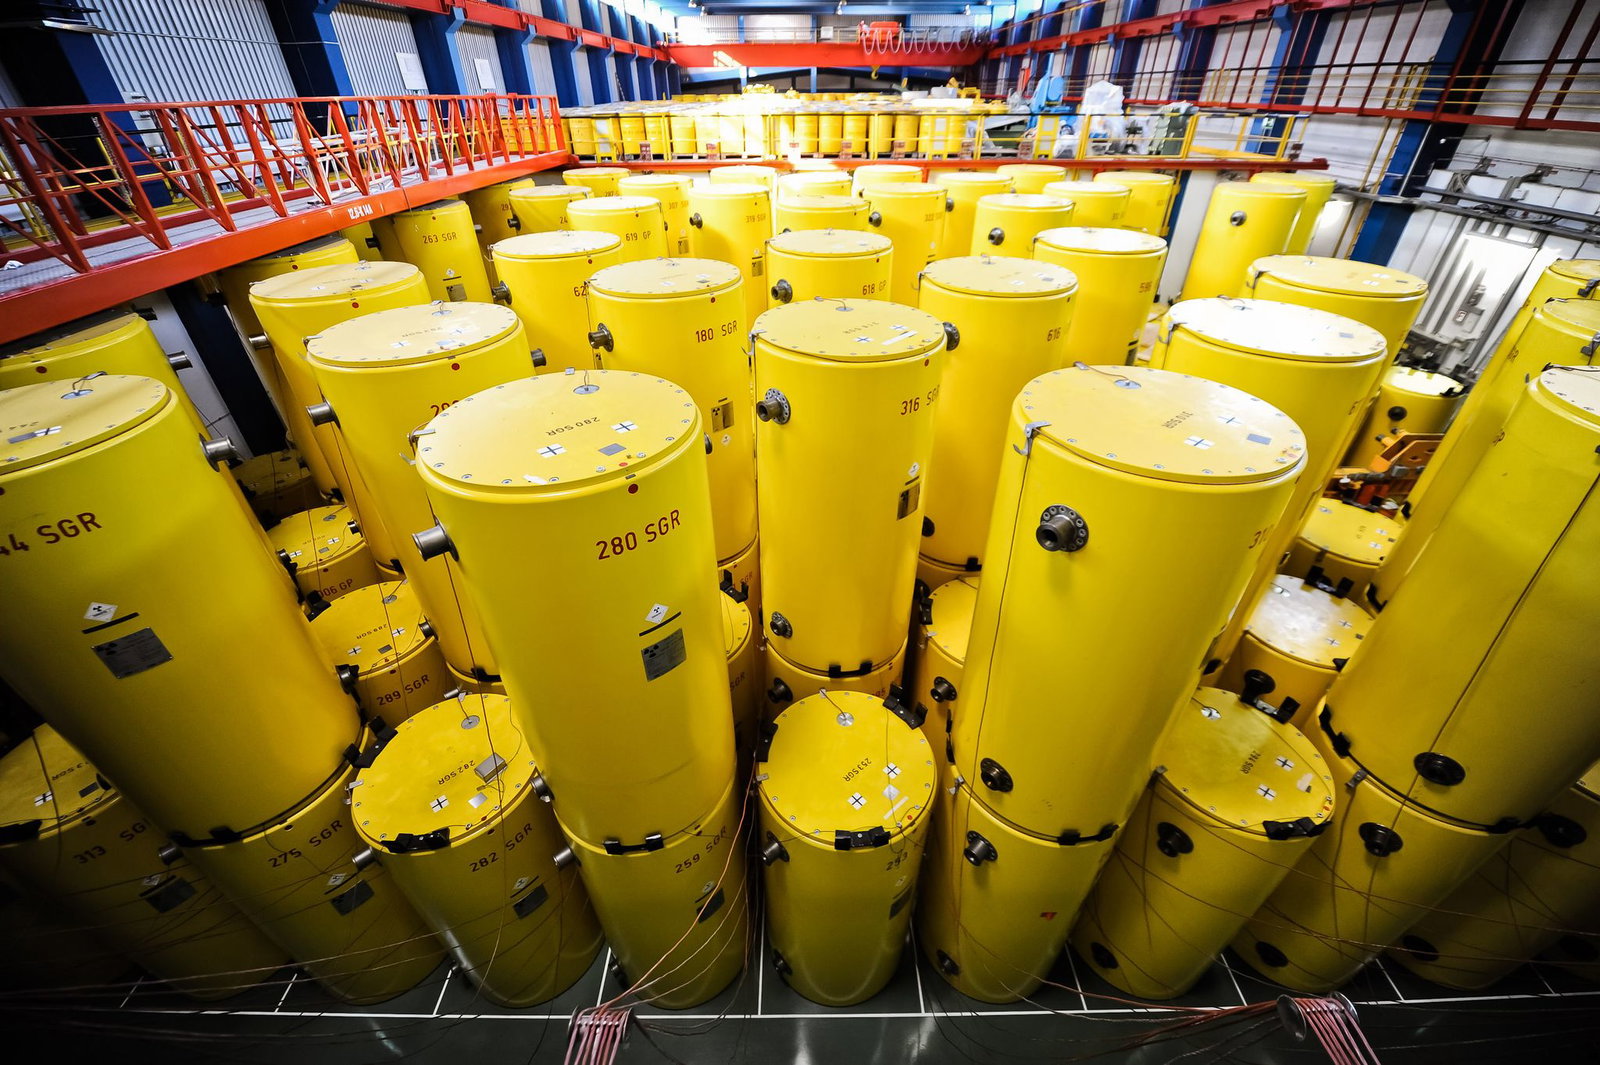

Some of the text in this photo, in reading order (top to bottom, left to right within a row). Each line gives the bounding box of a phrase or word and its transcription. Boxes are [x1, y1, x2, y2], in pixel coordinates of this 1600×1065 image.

[422, 231, 458, 245] 263 SGR
[625, 230, 652, 241] 619 GP
[573, 285, 588, 297] 62
[862, 284, 875, 296] 618
[696, 320, 738, 343] 180 SGR
[900, 397, 920, 416] 316
[546, 417, 600, 437] 280 SGR
[37, 512, 102, 544] SGR
[596, 509, 681, 560] 280 SGR
[339, 578, 354, 590] GP
[376, 674, 430, 706] 289 SGR
[52, 767, 75, 781] SGR
[438, 759, 476, 785] 282 SGR
[843, 757, 872, 782] 253 SGR
[72, 845, 107, 864] 313
[268, 819, 344, 869] 275 SGR
[469, 823, 534, 873] 282 SGR
[674, 825, 729, 874] 259 SGR
